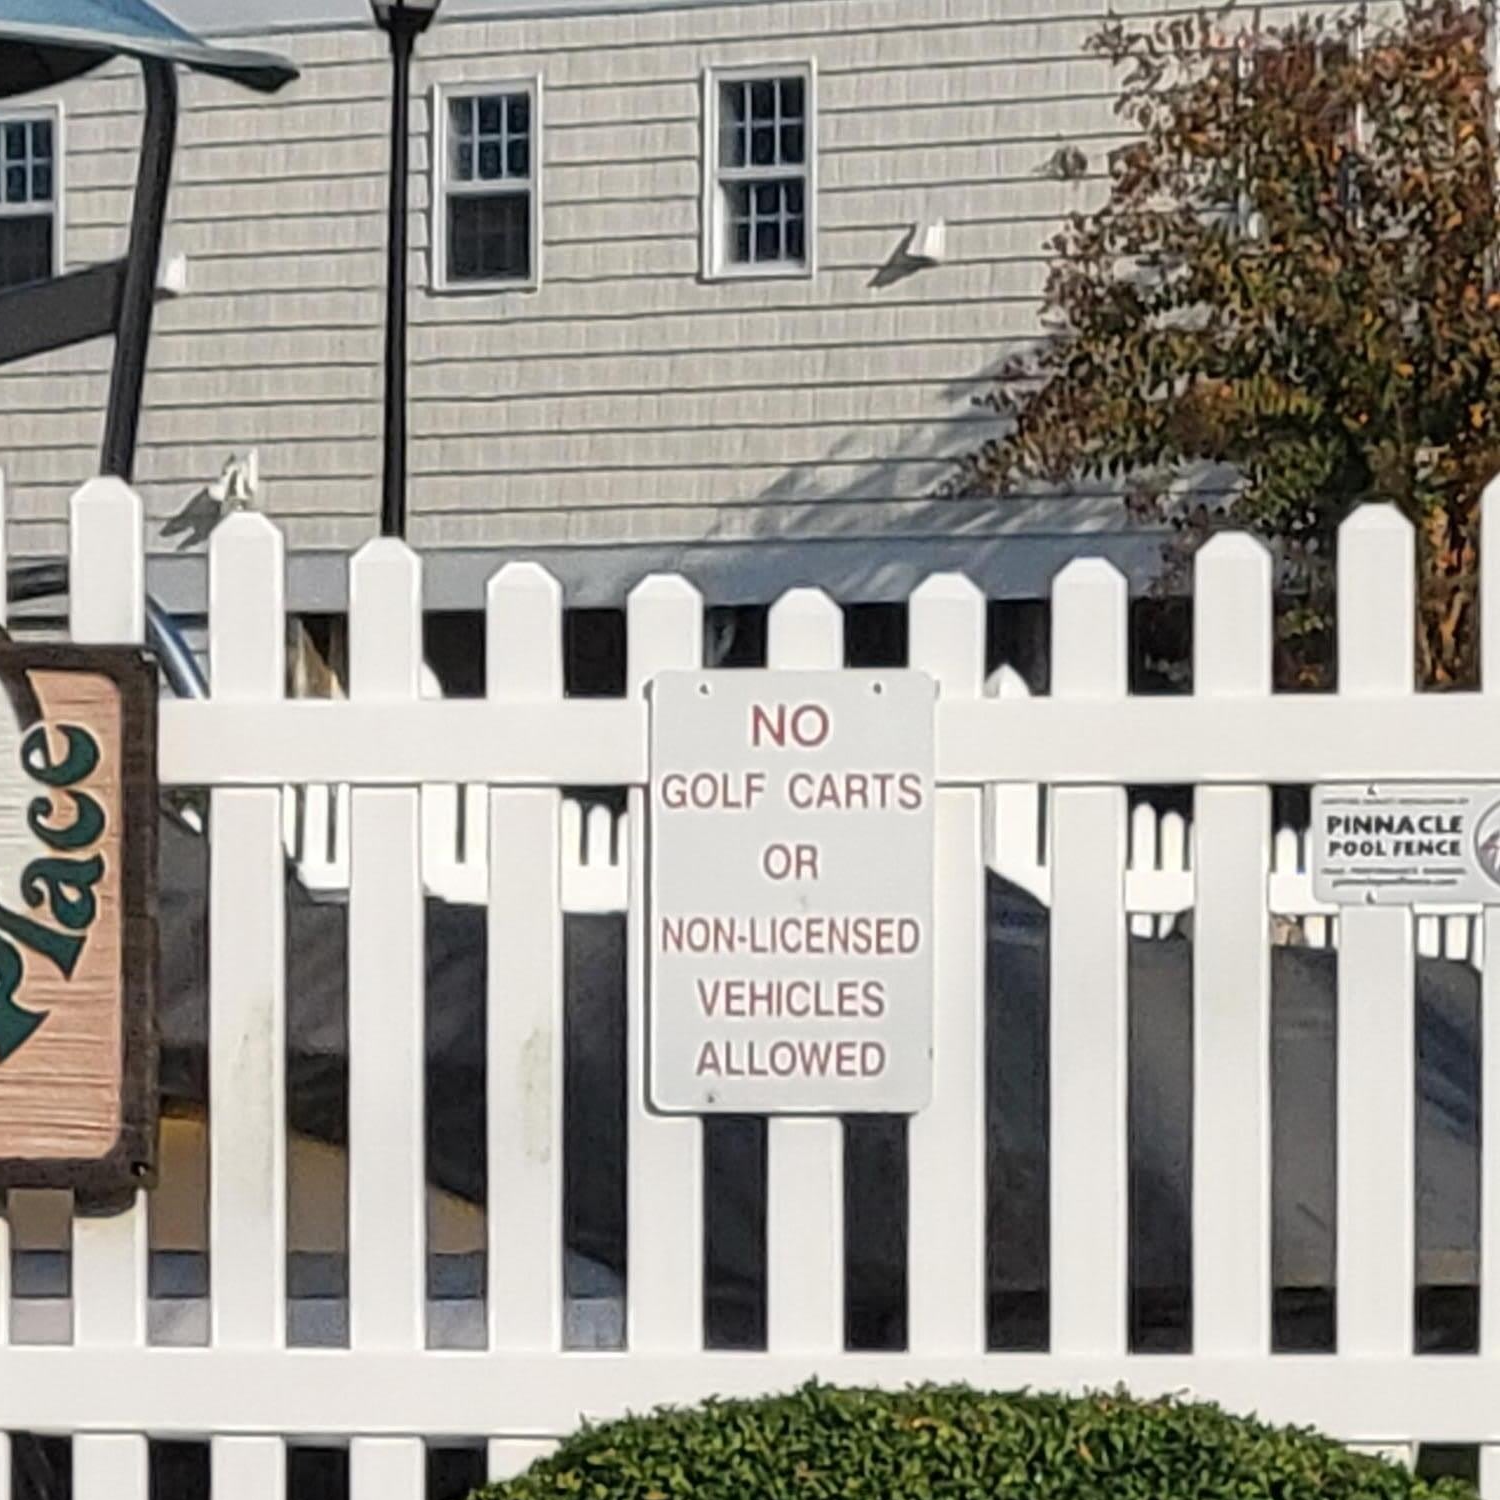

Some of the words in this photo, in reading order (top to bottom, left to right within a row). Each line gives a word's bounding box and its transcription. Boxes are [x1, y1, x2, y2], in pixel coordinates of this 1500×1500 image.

[752, 704, 830, 748] NO
[661, 773, 766, 809] GOLF
[789, 773, 923, 809] CARTS
[1326, 815, 1463, 834] PINNACLE
[763, 844, 819, 880] OR
[1328, 840, 1387, 857] POOL
[1393, 840, 1462, 857] FENCE
[662, 917, 921, 954] NON-LICENSED
[698, 979, 886, 1017] VEHICLES
[696, 1040, 886, 1077] ALLOWED
